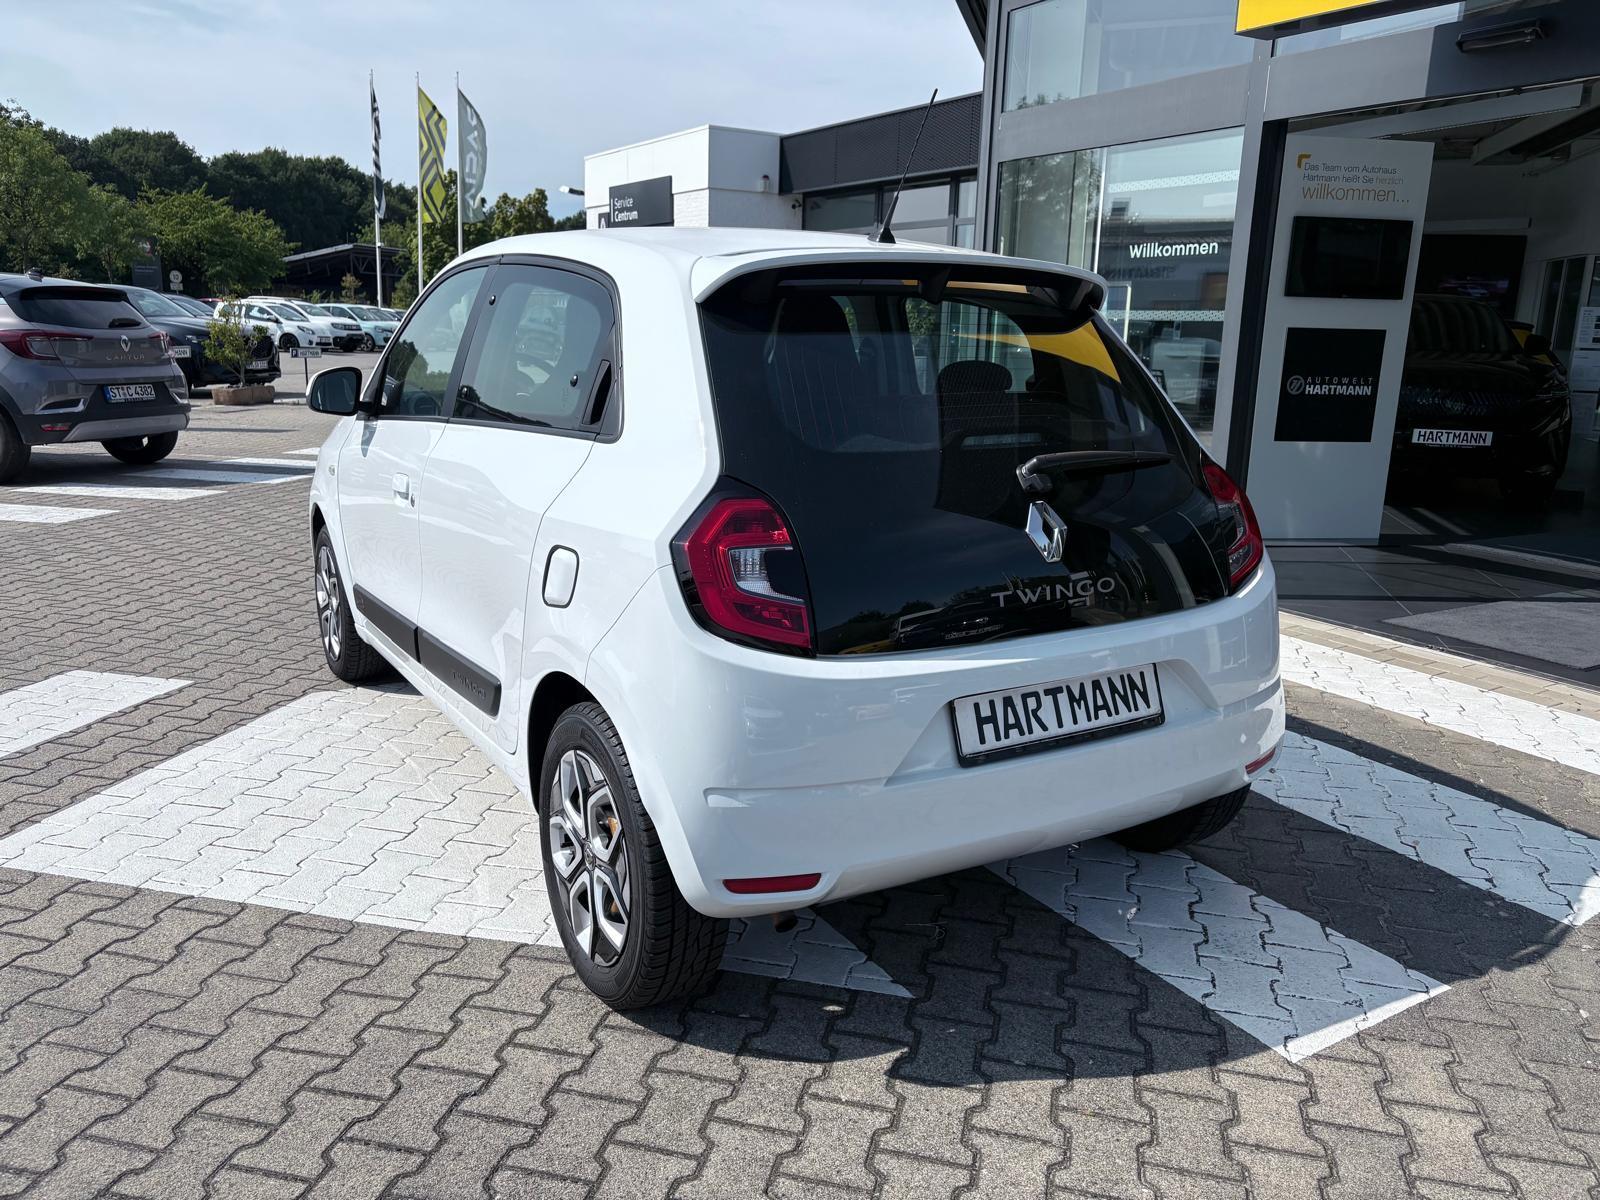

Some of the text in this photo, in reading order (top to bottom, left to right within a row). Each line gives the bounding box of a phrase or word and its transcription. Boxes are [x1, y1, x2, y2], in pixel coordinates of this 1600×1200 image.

[1304, 162, 1397, 175] Das Team vom Autohaus
[1303, 173, 1341, 182] Hartmann
[1343, 175, 1360, 183] heißt
[1362, 175, 1374, 184] Sie
[614, 196, 634, 209] Service
[614, 211, 639, 222] Centrum
[1129, 242, 1219, 258] Willkommen
[1306, 376, 1373, 384] AUTOWELT
[110, 385, 154, 398] ST C 4382
[1305, 384, 1372, 395] HARTMANN
[1417, 430, 1488, 445] HARTMANN
[990, 577, 1116, 608] TWINGO
[974, 671, 1151, 745] HARTMANN
